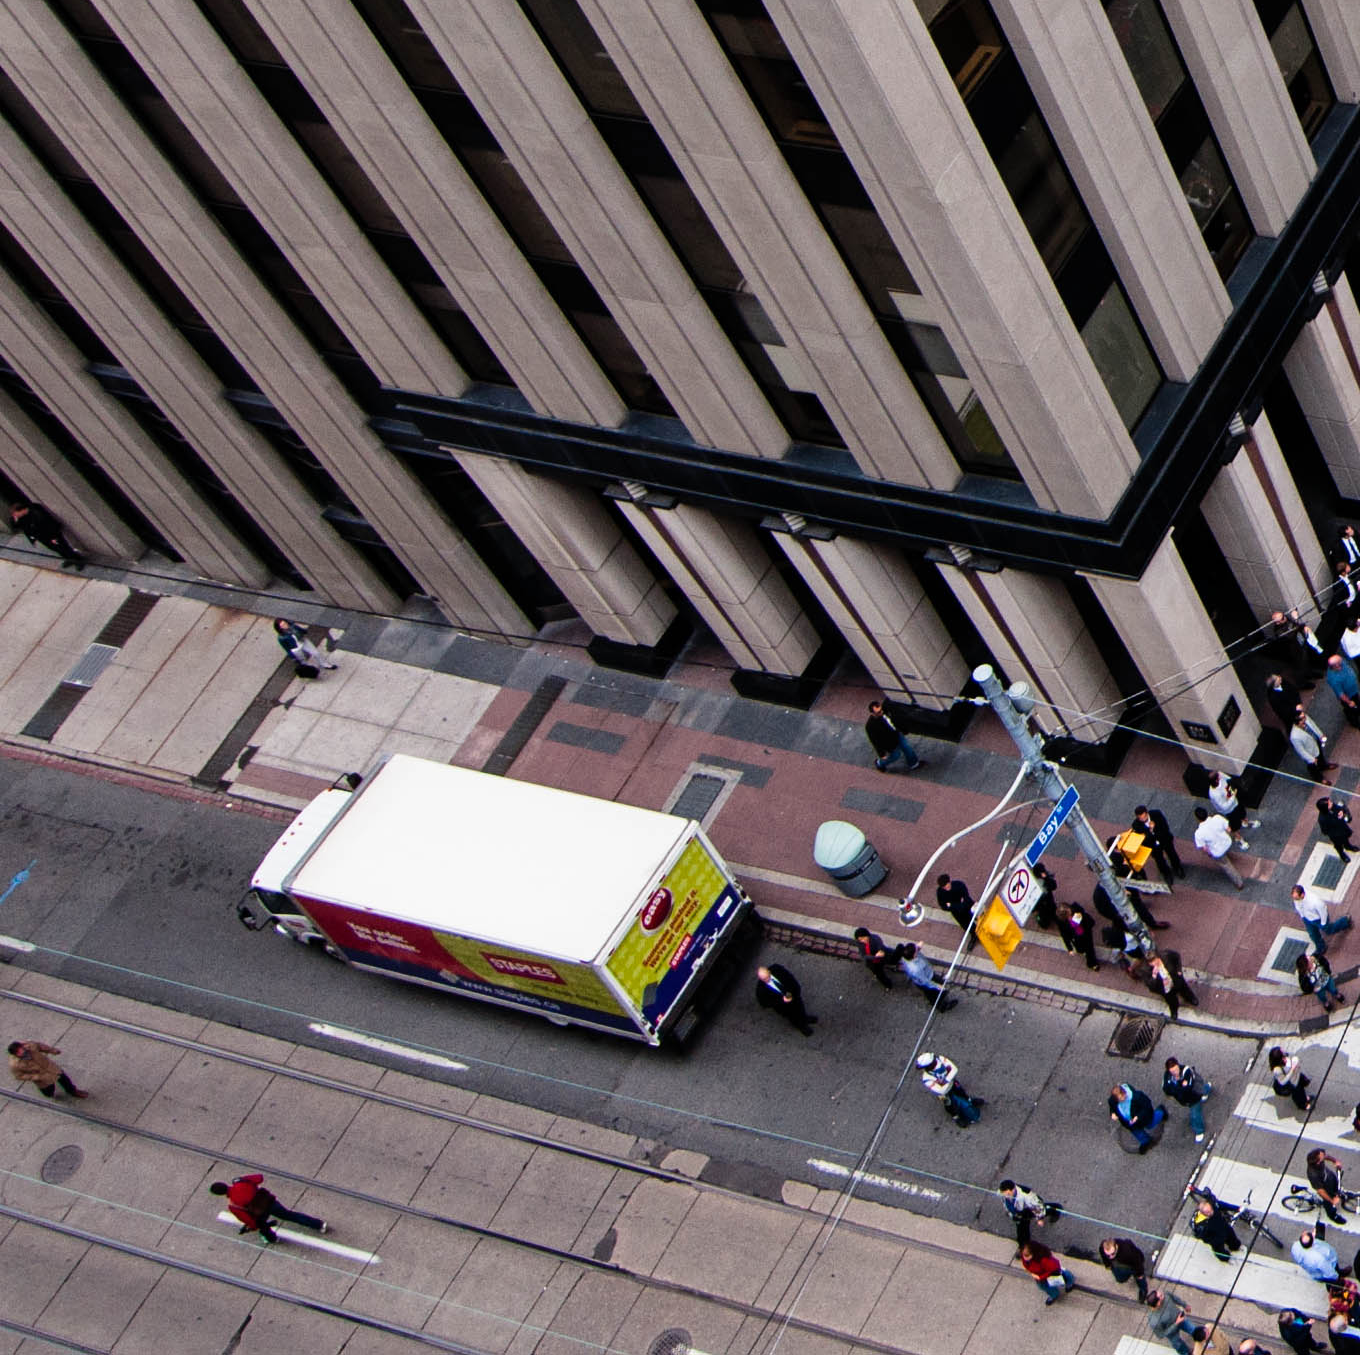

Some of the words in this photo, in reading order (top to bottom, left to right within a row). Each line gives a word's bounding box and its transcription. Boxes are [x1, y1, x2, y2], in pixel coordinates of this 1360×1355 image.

[1038, 815, 1061, 845] Bay
[643, 889, 667, 926] easy
[670, 935, 692, 966] STAPLES
[488, 956, 557, 980] STAPLES
